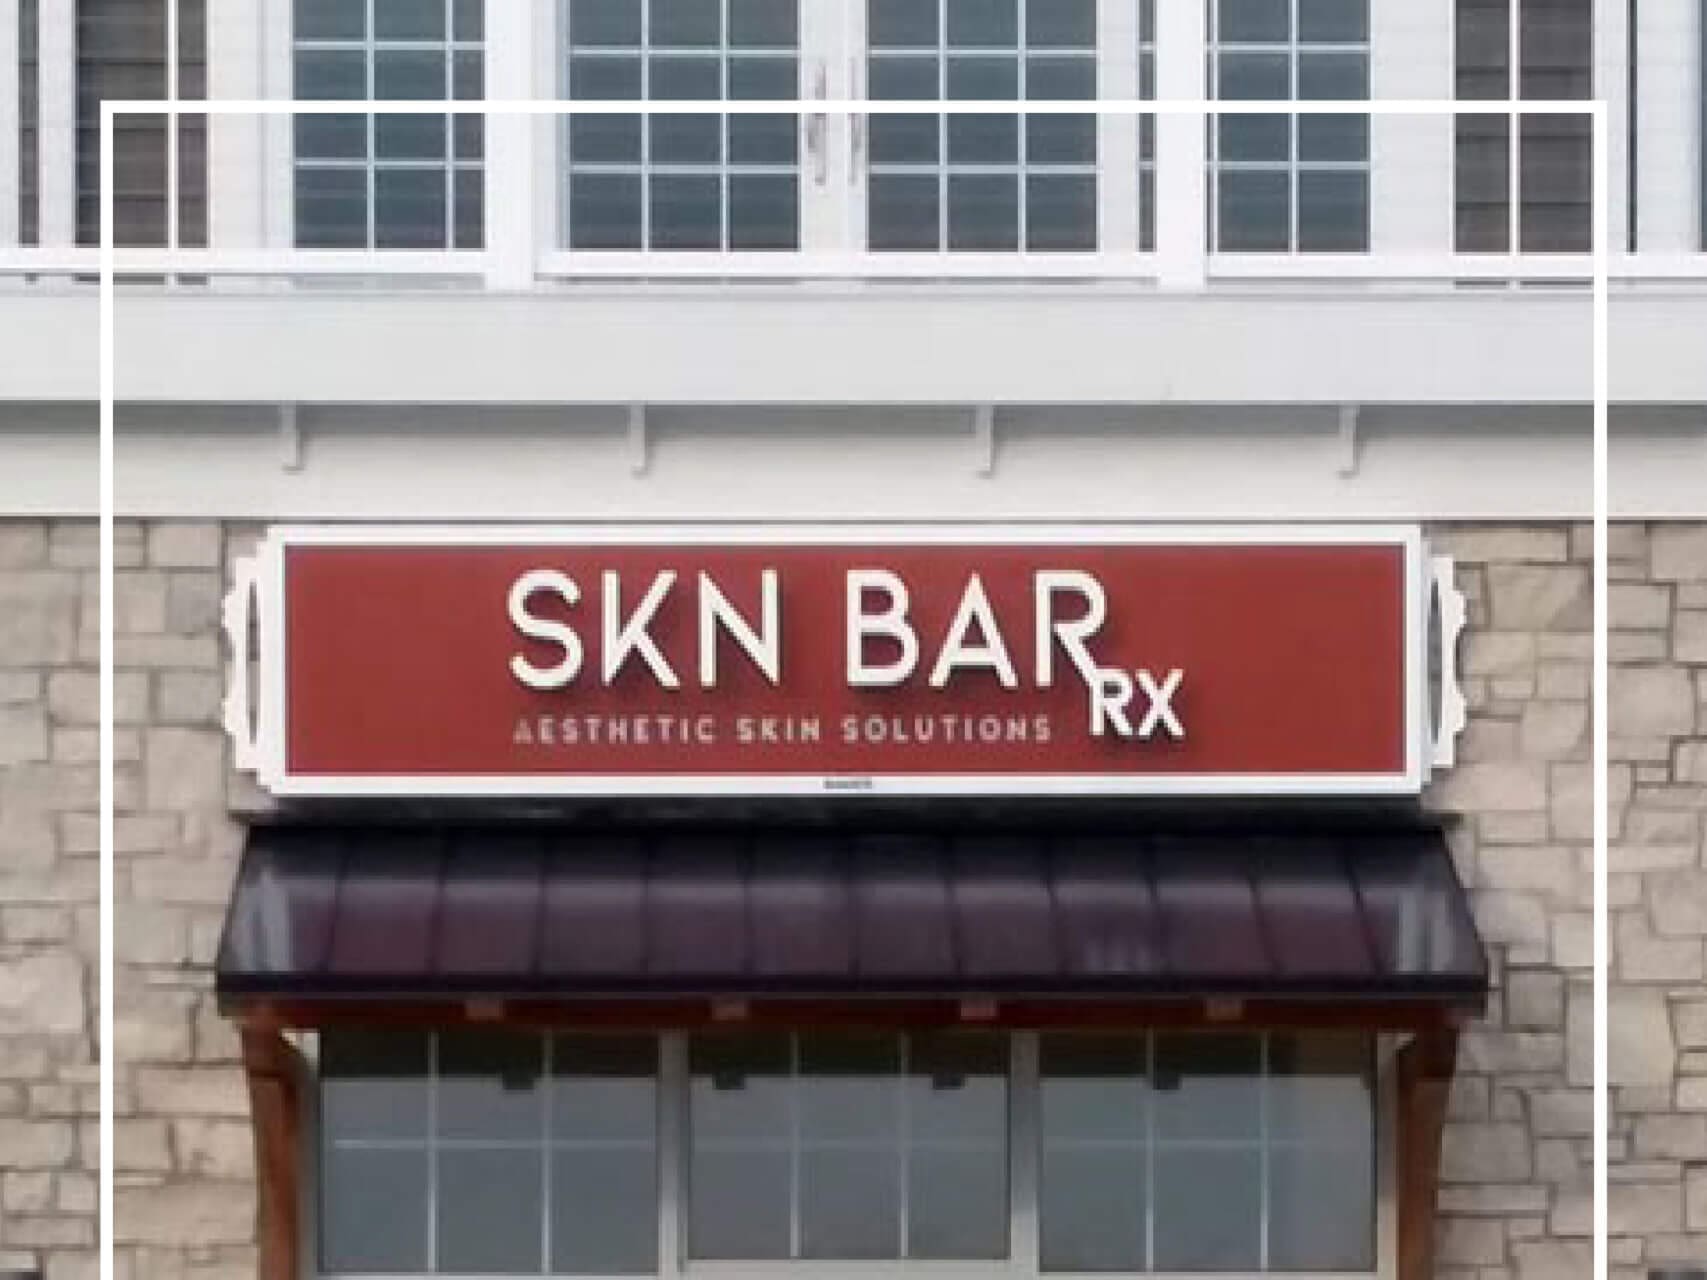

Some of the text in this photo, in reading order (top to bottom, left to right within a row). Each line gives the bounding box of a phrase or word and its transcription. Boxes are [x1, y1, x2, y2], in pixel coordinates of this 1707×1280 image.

[507, 569, 1108, 688] SKN BAR
[512, 716, 1051, 743] AESTHETIC SKIN SOLUTIONS
[1089, 668, 1185, 737] RX
